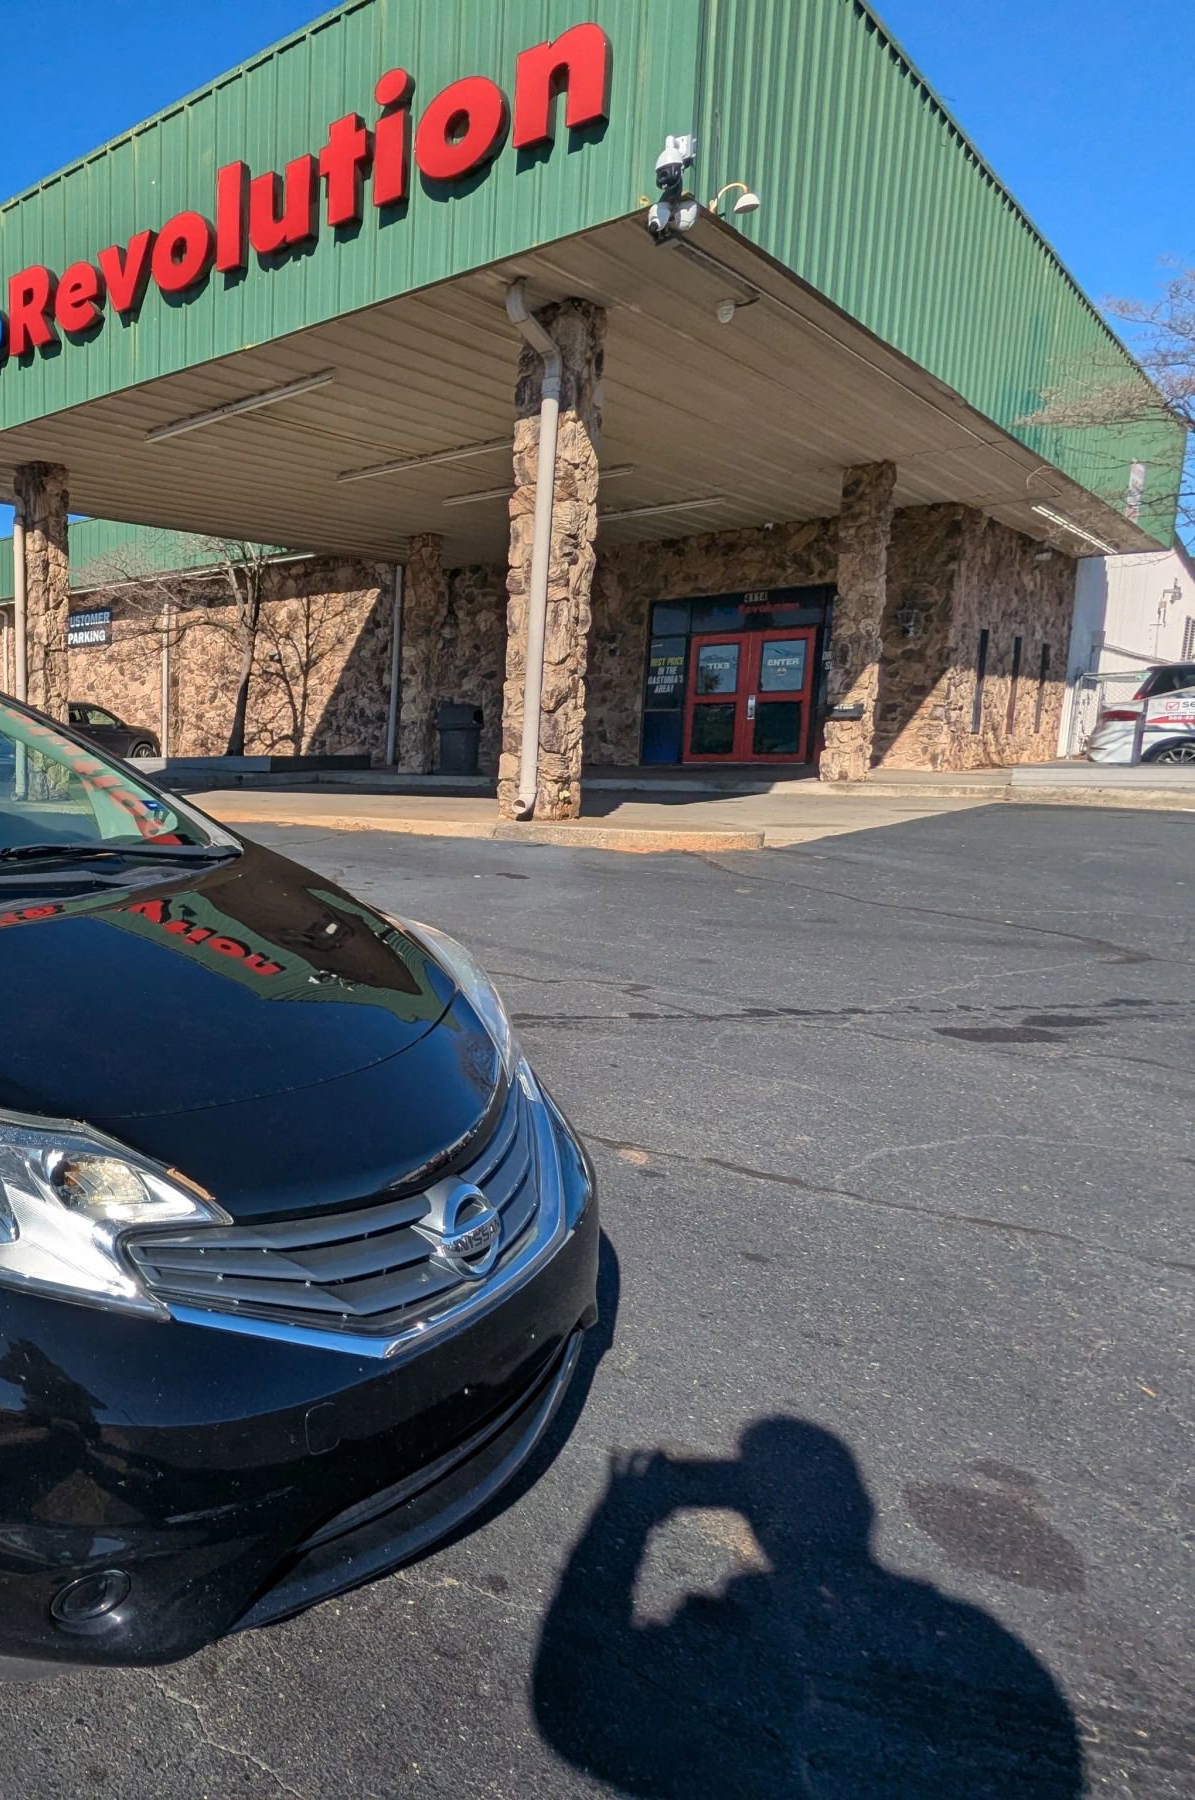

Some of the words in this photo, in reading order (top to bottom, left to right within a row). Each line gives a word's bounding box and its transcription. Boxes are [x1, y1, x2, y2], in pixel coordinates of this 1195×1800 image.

[744, 592, 768, 603] 4114
[69, 611, 110, 627] USTOMER
[68, 630, 106, 645] PARKING
[767, 657, 799, 666] ENTER
[452, 1219, 500, 1252] NISSAN
